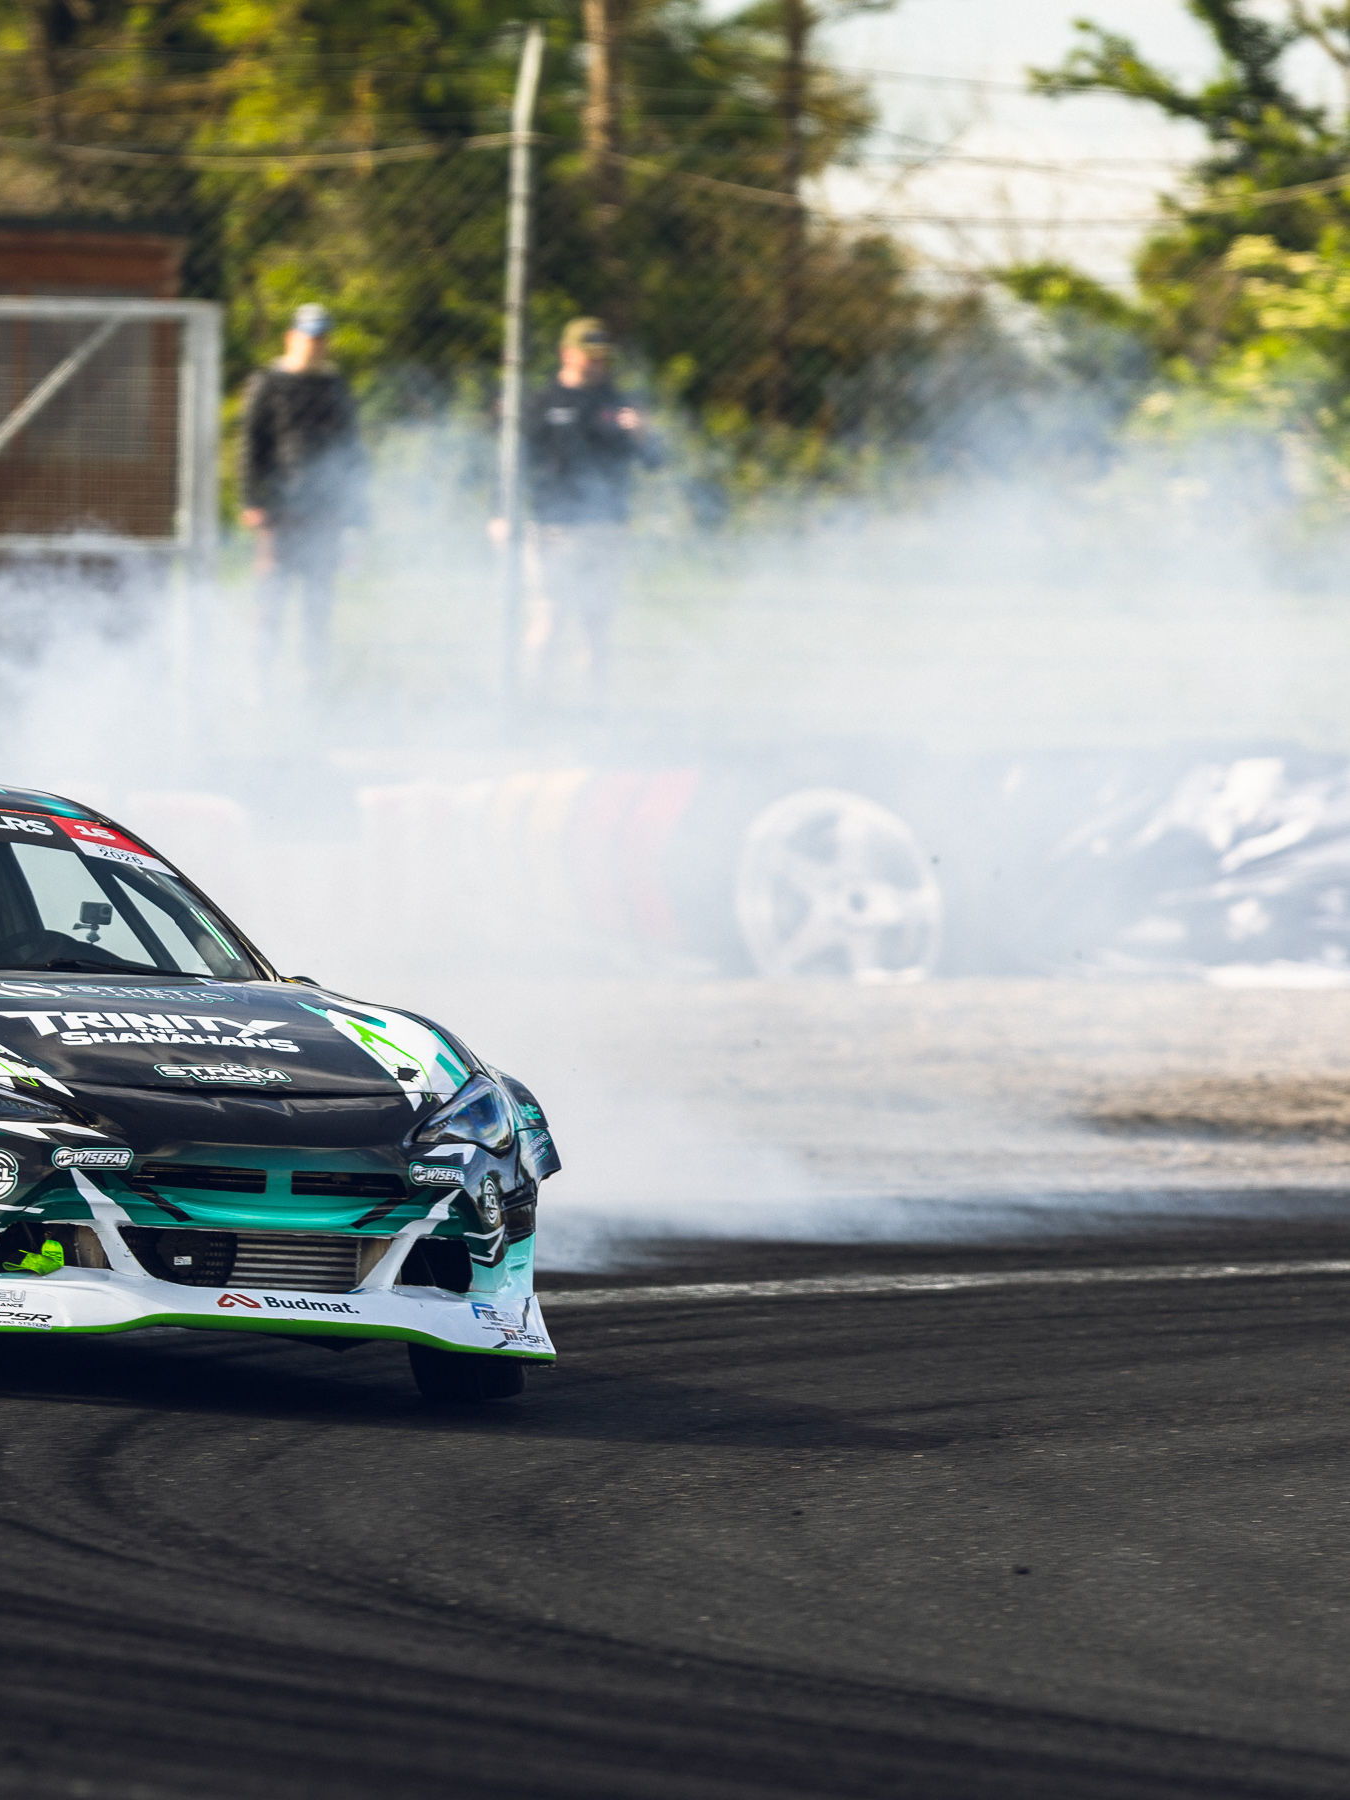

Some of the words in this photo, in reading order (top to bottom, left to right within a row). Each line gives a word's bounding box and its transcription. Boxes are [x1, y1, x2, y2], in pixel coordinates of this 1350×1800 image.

[74, 825, 116, 840] 16
[56, 985, 227, 1001] ESTHETIC
[61, 1031, 301, 1053] SHANAHANS
[160, 1065, 287, 1080] STRÖM
[199, 1075, 261, 1083] WHEELS
[73, 1152, 131, 1164] WISEFAB
[263, 1295, 361, 1314] Budmat.
